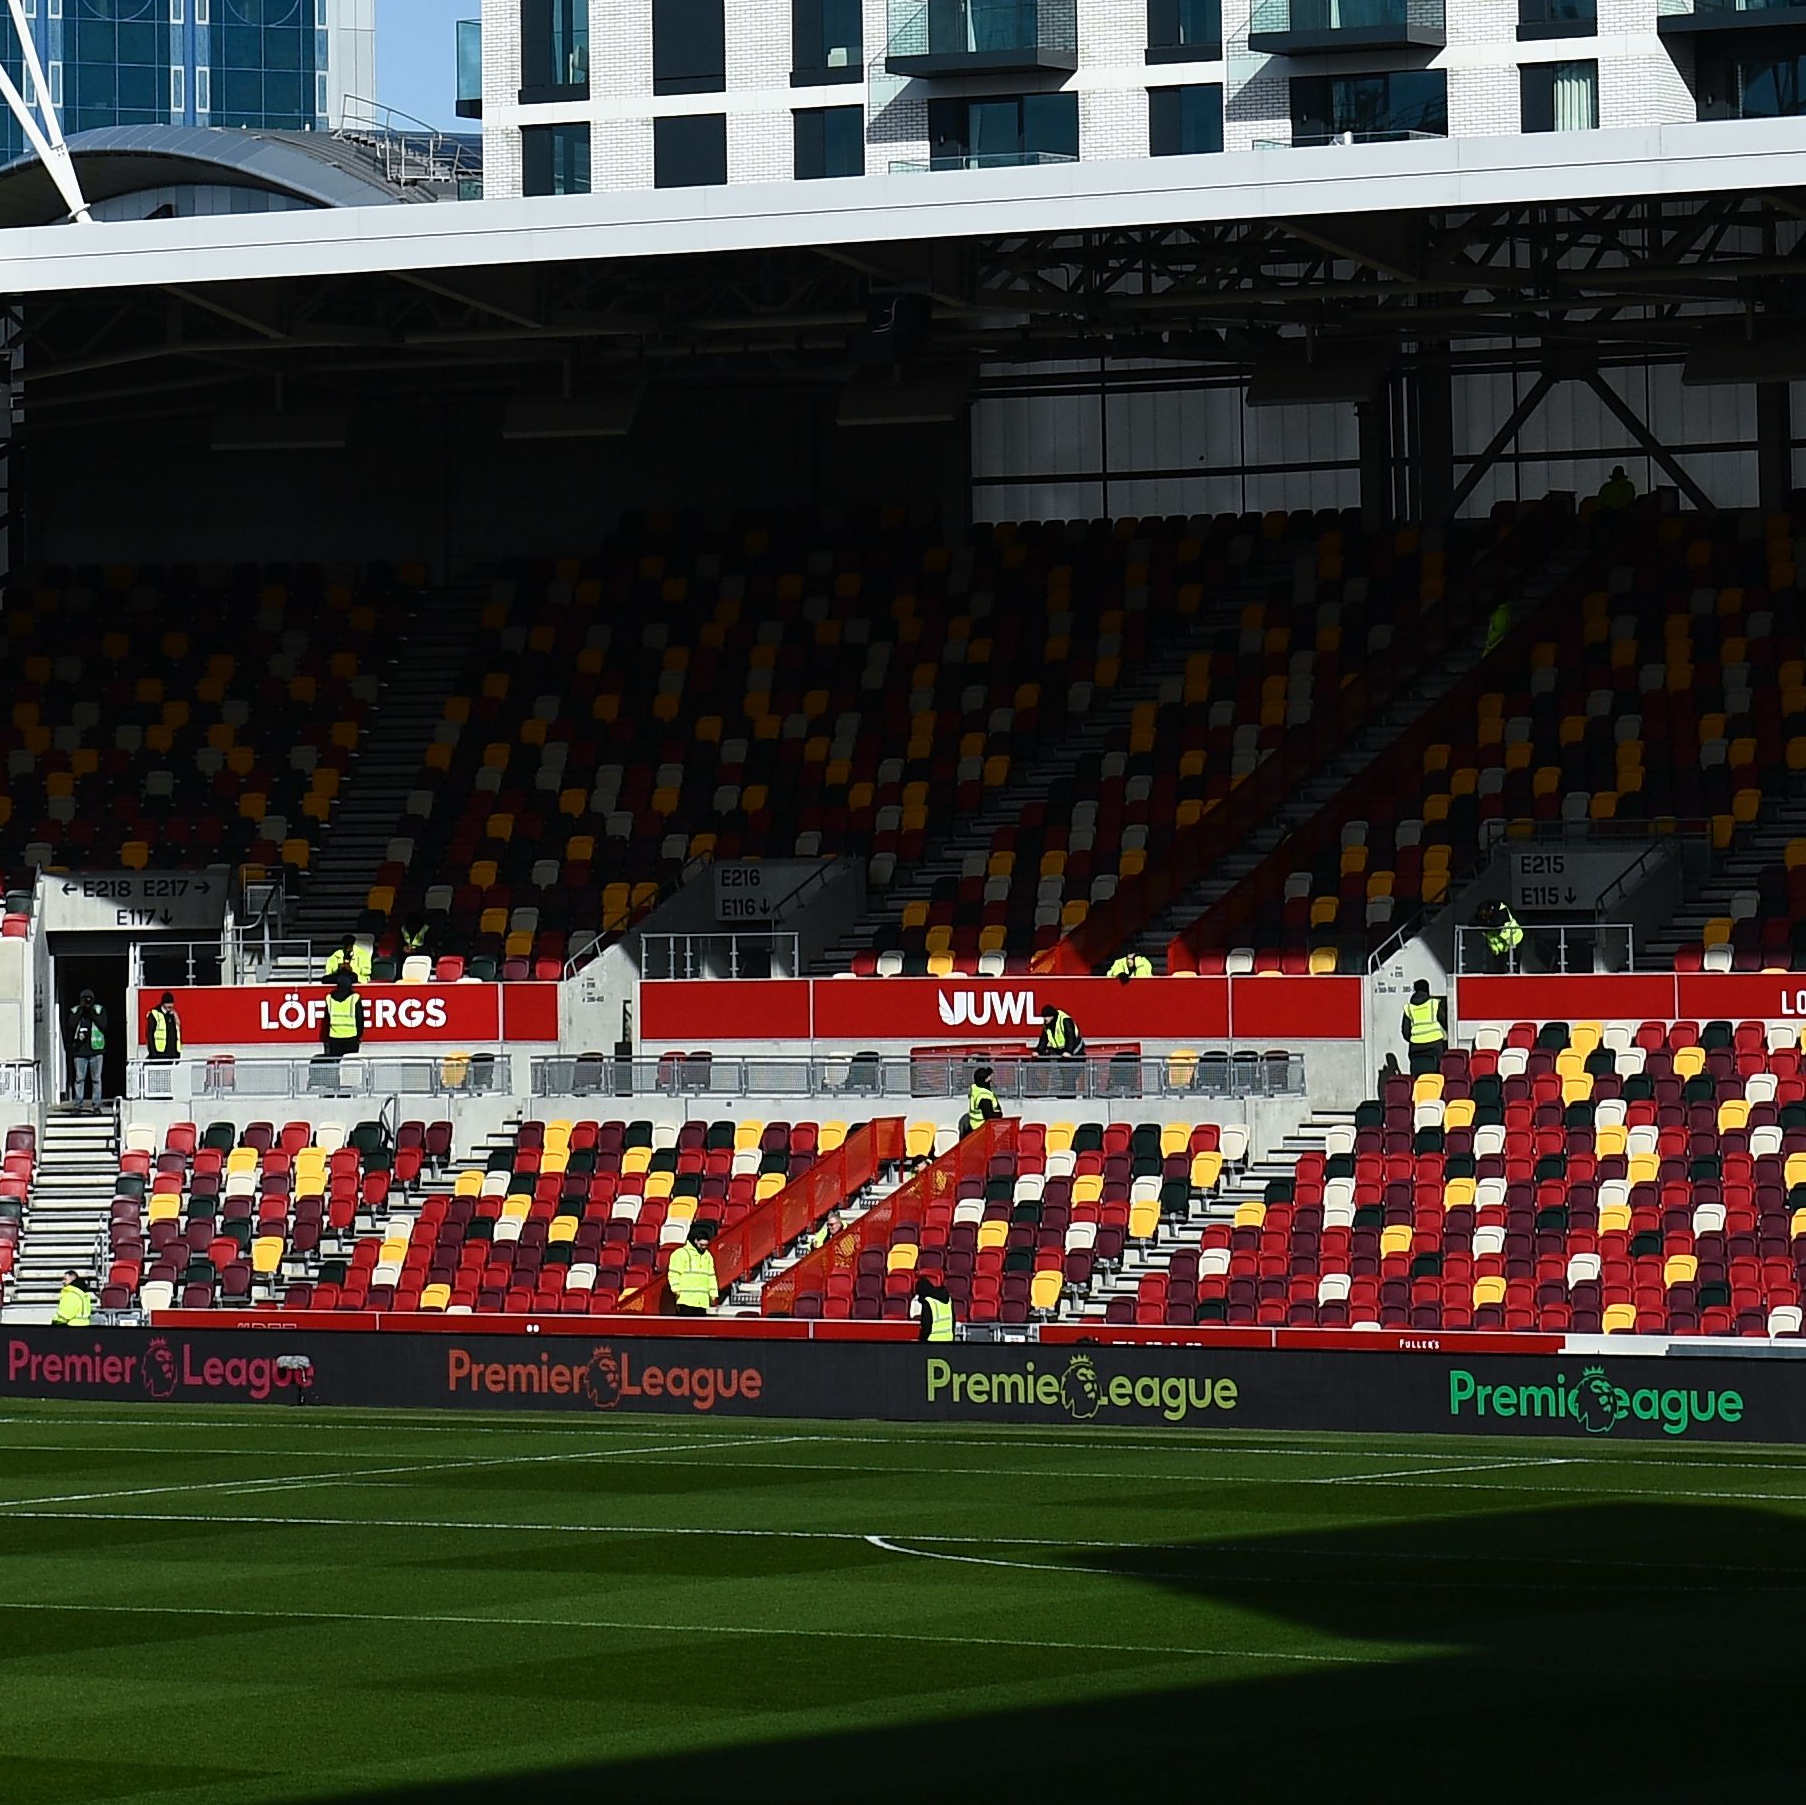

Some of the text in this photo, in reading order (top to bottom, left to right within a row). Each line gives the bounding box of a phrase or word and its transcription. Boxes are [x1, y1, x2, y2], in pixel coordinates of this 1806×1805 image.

[1521, 855, 1564, 874] E215
[721, 869, 760, 887] E216
[83, 880, 189, 897] E218 E217
[1521, 887, 1559, 905] E115
[722, 898, 756, 916] E116
[116, 909, 156, 925] E117
[260, 993, 447, 1029] LÖFERGS
[8, 1339, 137, 1384] Premier
[449, 1348, 762, 1410] Premier League
[926, 1357, 1061, 1406] Premie
